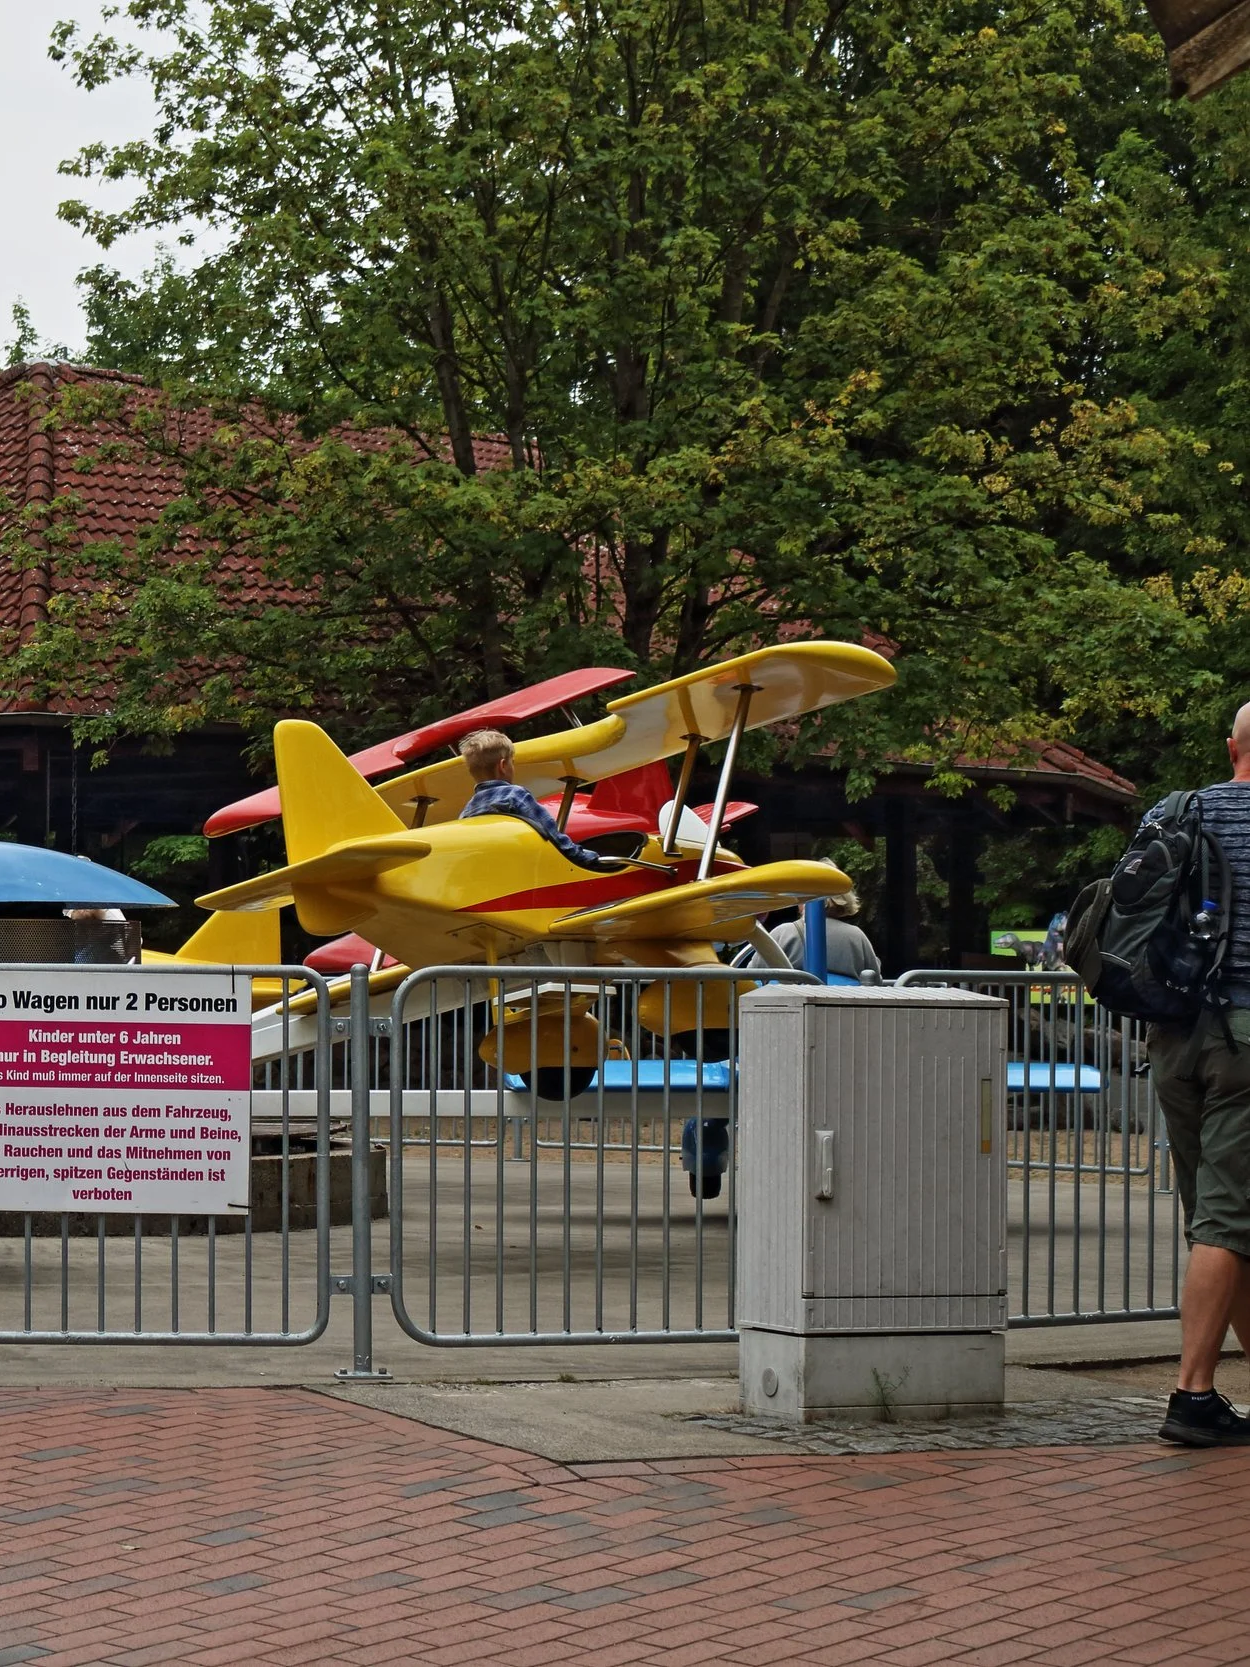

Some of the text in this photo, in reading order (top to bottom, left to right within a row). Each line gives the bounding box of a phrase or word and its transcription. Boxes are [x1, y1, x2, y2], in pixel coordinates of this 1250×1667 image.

[13, 991, 79, 1013] Wagen
[87, 996, 120, 1010] nur
[126, 993, 137, 1010] 2
[145, 993, 237, 1012] Personen
[29, 1029, 180, 1044] Kinder unter 6 Jahren
[24, 1050, 36, 1062] in
[41, 1050, 115, 1066] Begleitung
[121, 1051, 213, 1065] Erwachsener.
[7, 1070, 29, 1080] Kind
[33, 1071, 55, 1080] muß
[59, 1071, 91, 1081] immer
[95, 1072, 111, 1081] auf
[115, 1072, 131, 1082] der
[135, 1072, 187, 1083] Innenseite
[191, 1073, 224, 1083] sitzen.
[6, 1103, 98, 1116] Herauslehnen
[103, 1107, 127, 1117] aus
[132, 1105, 160, 1117] dem
[166, 1106, 231, 1121] Fahrzeug,
[104, 1125, 126, 1137] der
[130, 1126, 165, 1138] Arme
[170, 1127, 195, 1139] und
[201, 1127, 241, 1142] Beine,
[4, 1144, 62, 1157] Rauchen
[68, 1146, 92, 1158] und
[97, 1146, 121, 1158] das
[126, 1147, 202, 1160] Mitnehmen
[207, 1151, 230, 1160] von
[54, 1166, 102, 1181] spitzen
[107, 1167, 203, 1182] Gegenständen
[208, 1169, 225, 1181] ist
[73, 1188, 132, 1200] verboten
